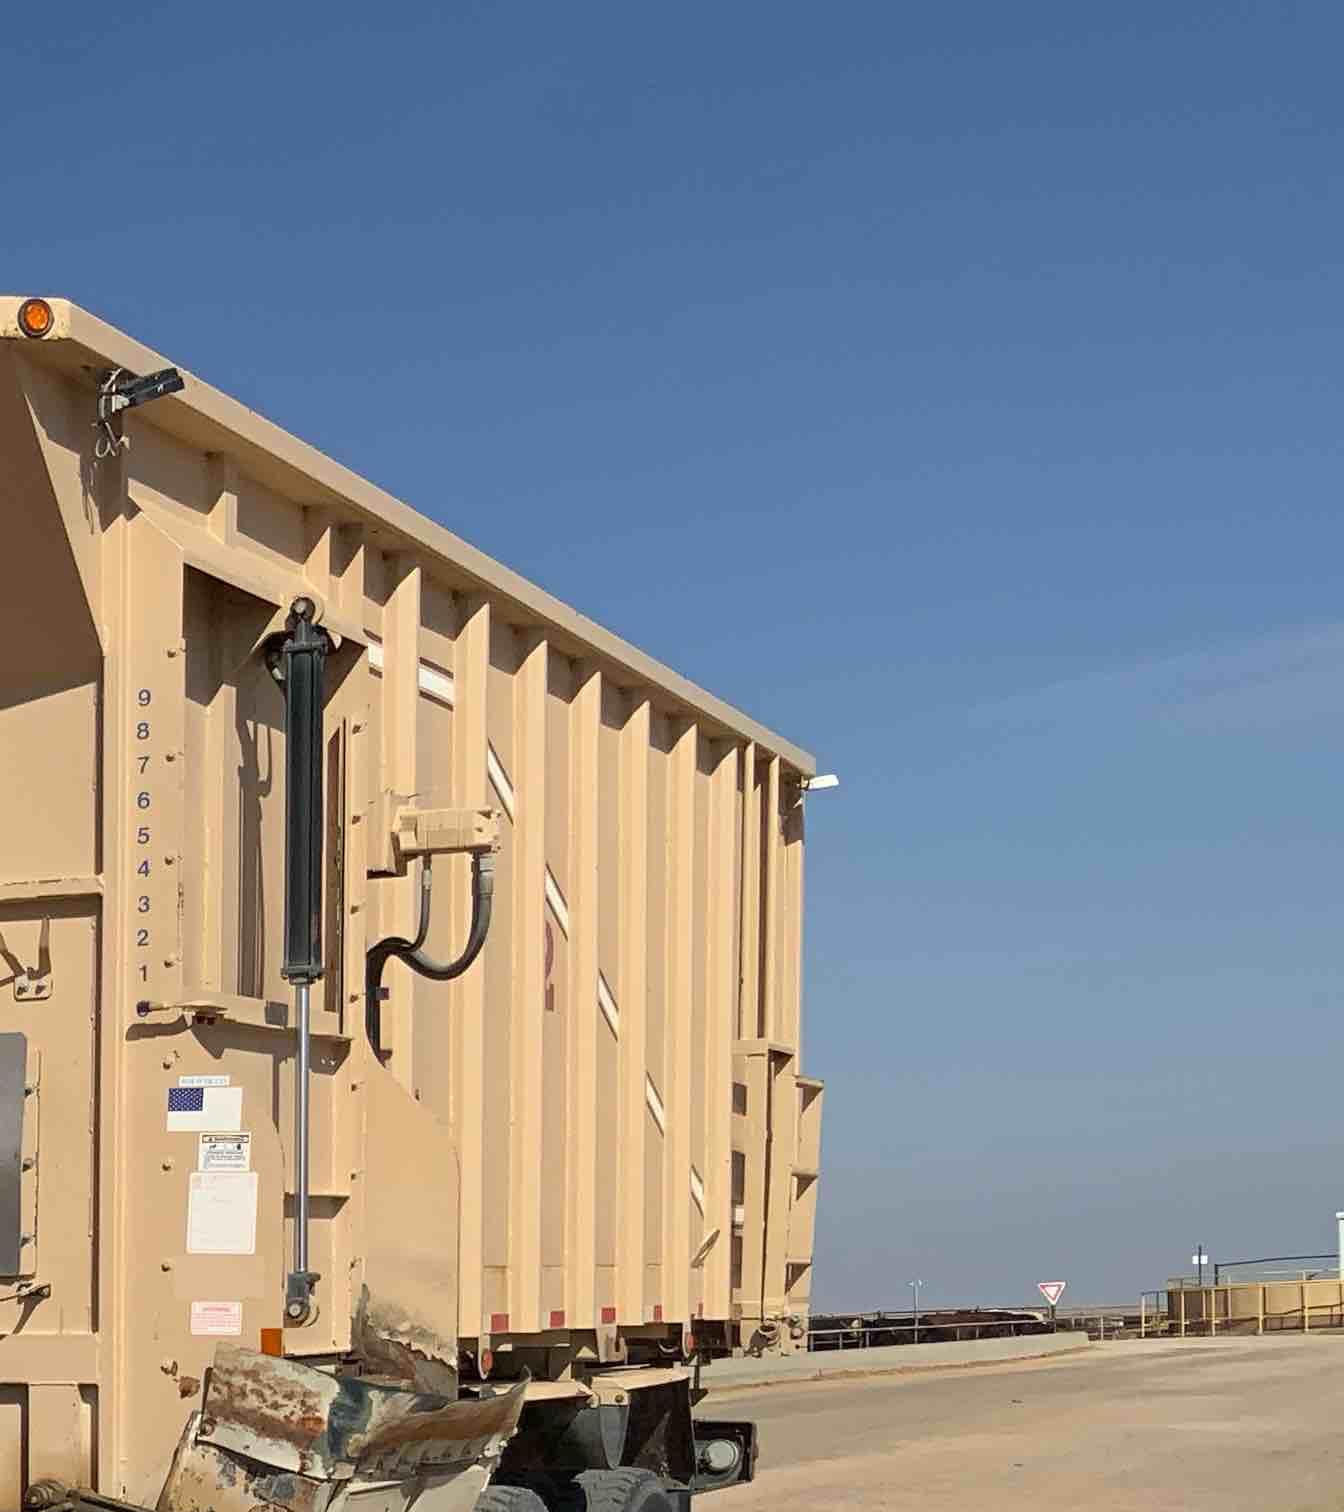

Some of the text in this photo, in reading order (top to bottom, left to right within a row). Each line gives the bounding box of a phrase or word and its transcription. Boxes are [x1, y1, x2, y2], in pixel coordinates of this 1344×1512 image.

[138, 688, 151, 707] 9
[136, 722, 150, 740] 8
[137, 756, 150, 774] 7
[137, 791, 150, 809] 6
[137, 827, 150, 845] 5
[137, 860, 150, 877] 4
[138, 895, 150, 913] 3
[137, 928, 149, 946] 2
[139, 964, 147, 982] 1
